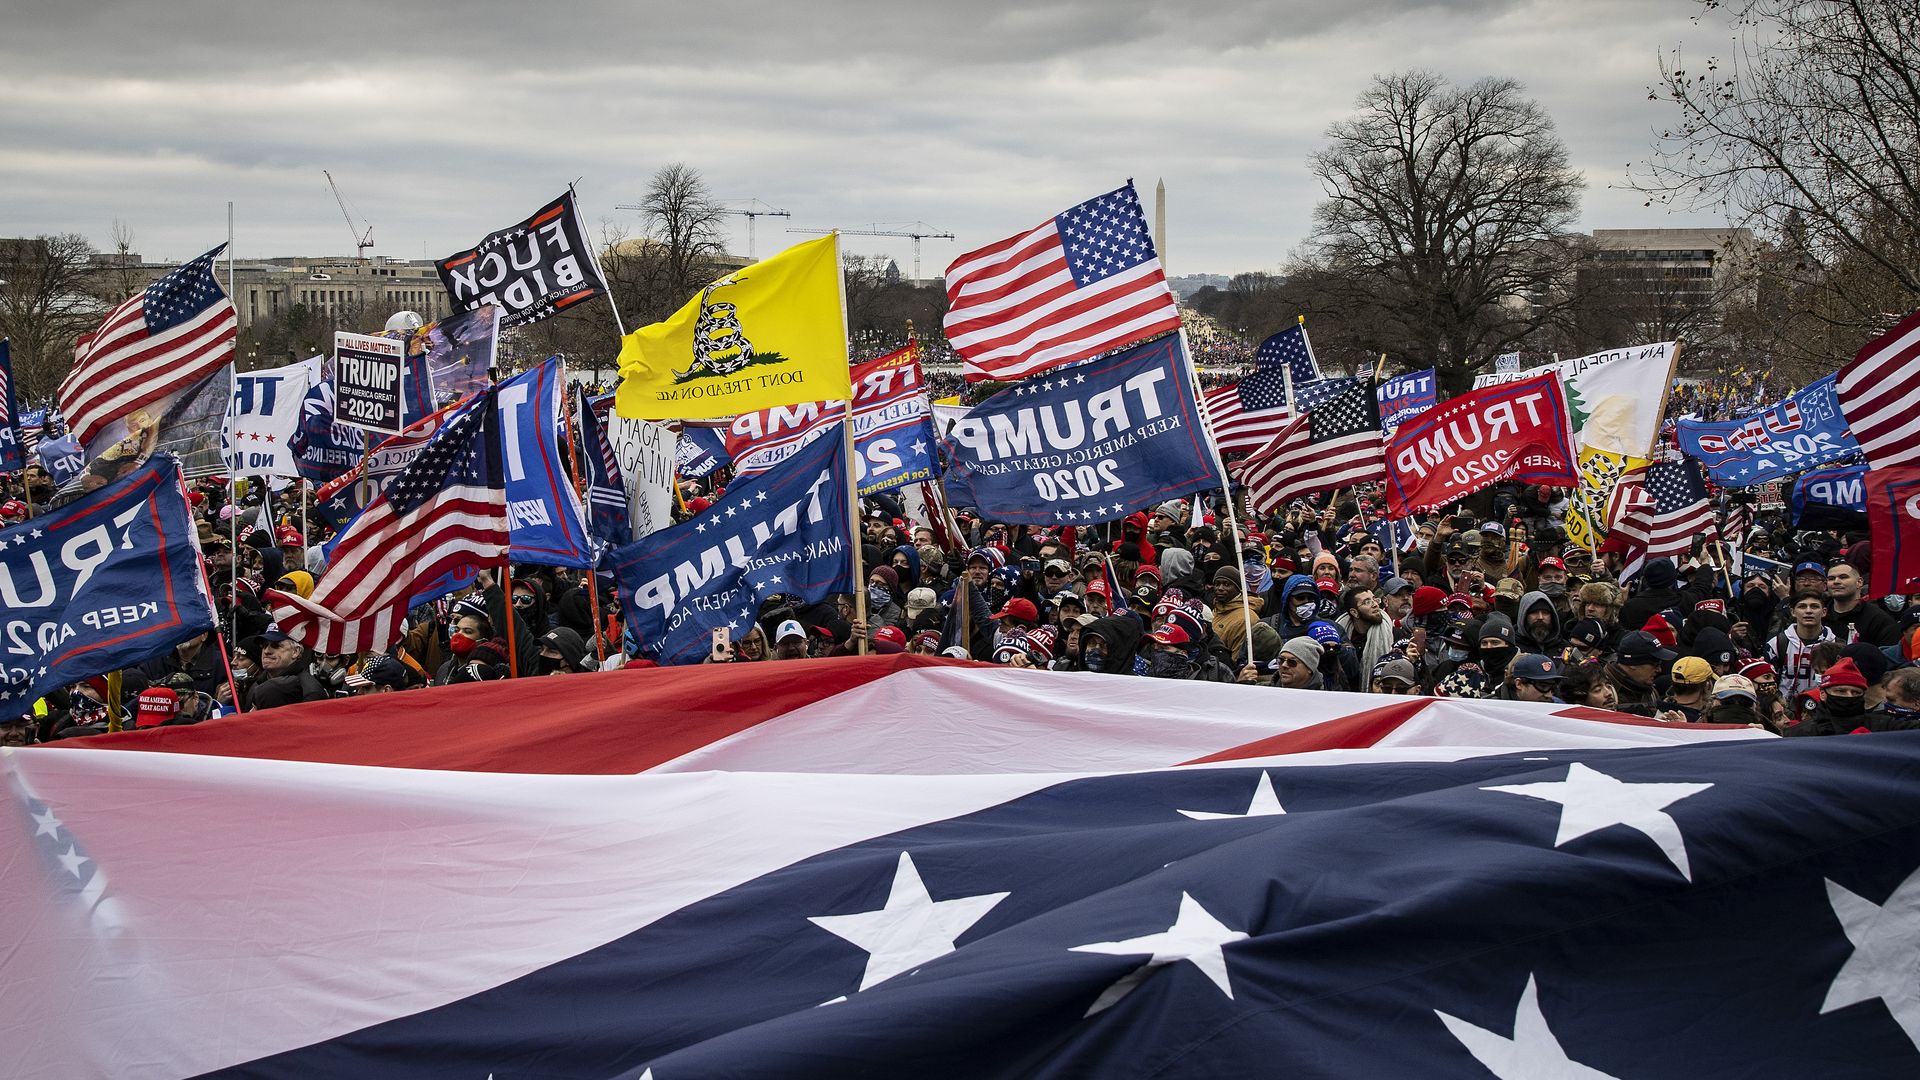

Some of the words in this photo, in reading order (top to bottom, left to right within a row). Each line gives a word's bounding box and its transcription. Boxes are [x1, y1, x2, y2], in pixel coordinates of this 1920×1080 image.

[345, 339, 355, 349] ALL
[354, 341, 369, 351] LIVES
[370, 342, 392, 354] MATTER
[340, 356, 398, 390] TRUMP
[340, 386, 351, 394] KEEP
[352, 388, 373, 399] AMERICA
[374, 392, 392, 402] GREAT
[348, 398, 384, 421] 2020
[620, 416, 661, 452] MAGA
